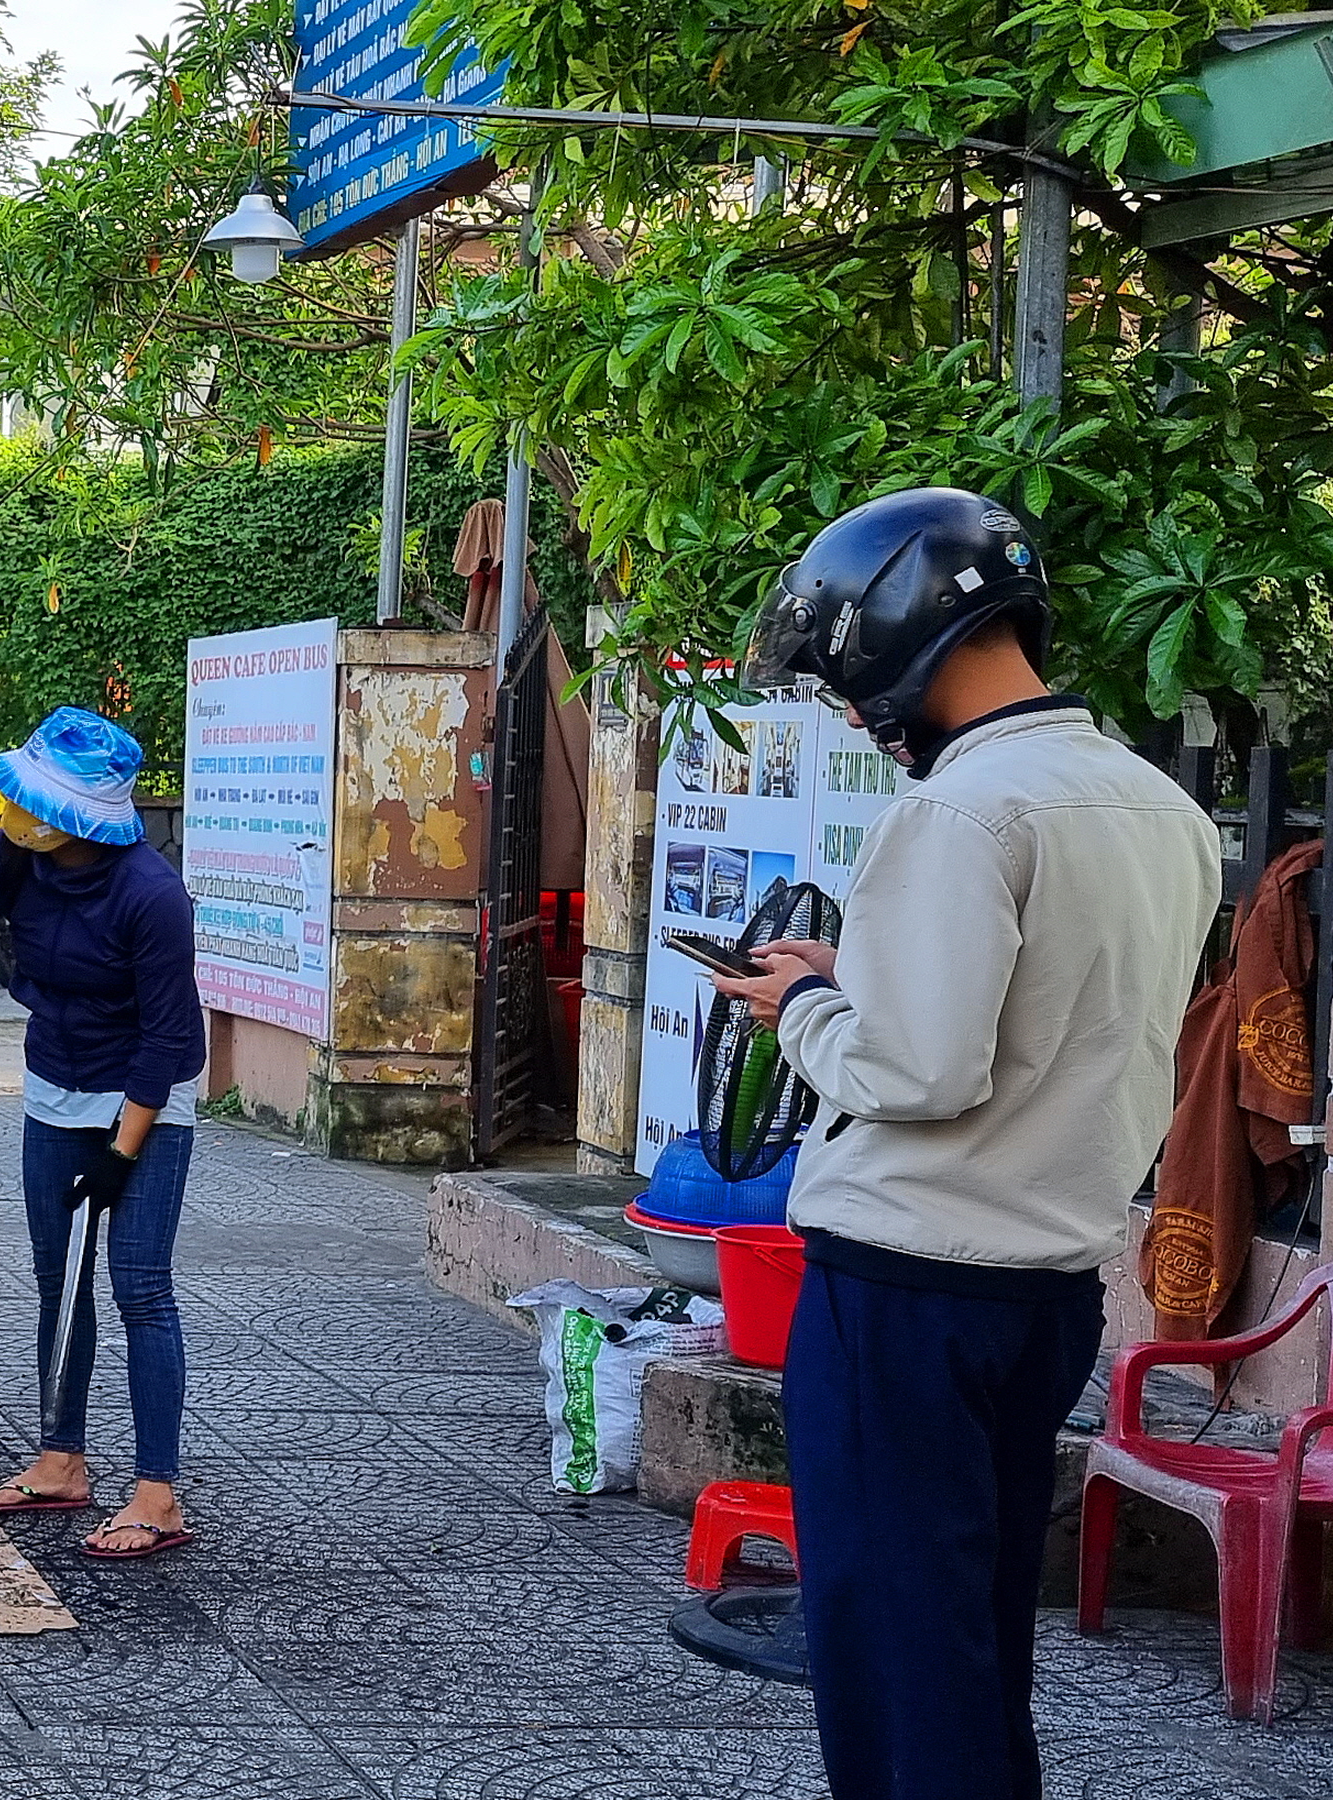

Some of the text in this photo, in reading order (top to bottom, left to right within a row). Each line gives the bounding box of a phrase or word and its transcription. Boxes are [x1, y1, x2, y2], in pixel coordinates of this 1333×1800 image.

[191, 643, 328, 687] QUEEN CAFE OPEN BUS
[667, 803, 727, 833] VIP 22 CABIN
[823, 823, 841, 866] VISA
[650, 1004, 688, 1039] Hội An
[645, 1115, 664, 1150] Hội
